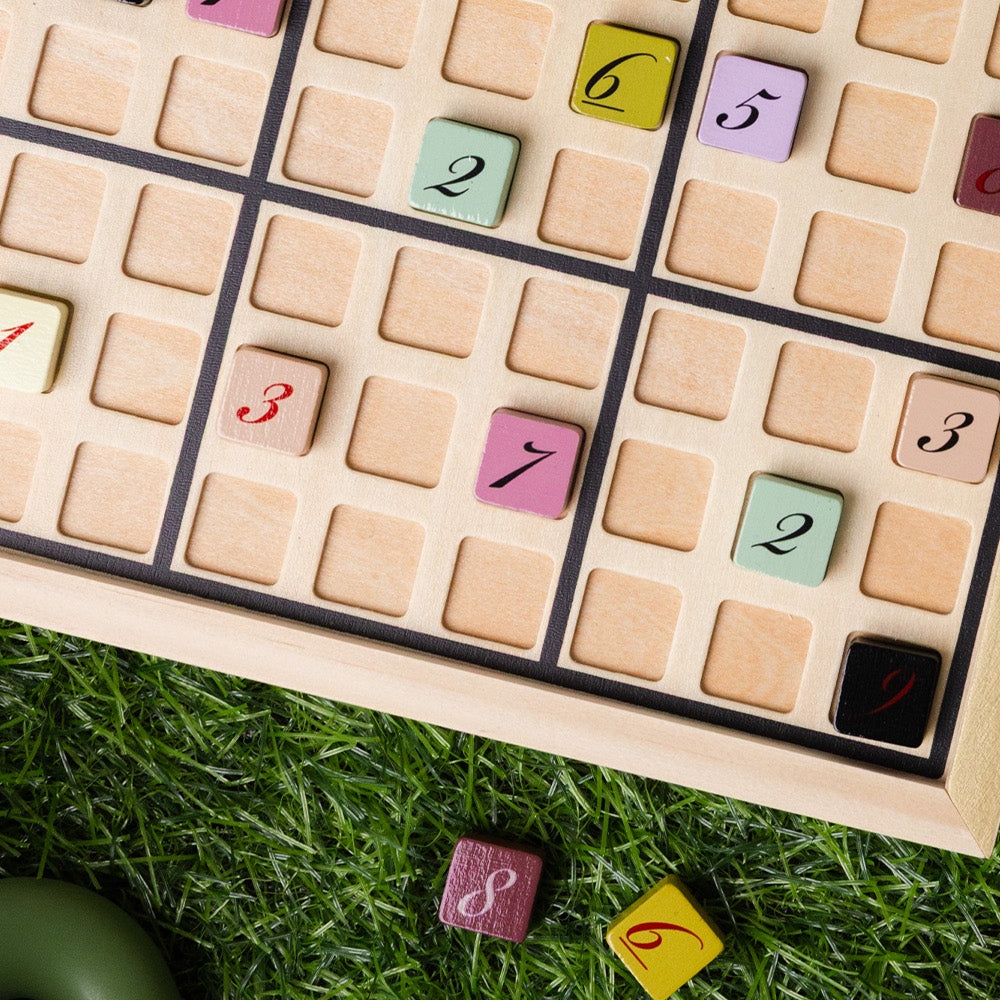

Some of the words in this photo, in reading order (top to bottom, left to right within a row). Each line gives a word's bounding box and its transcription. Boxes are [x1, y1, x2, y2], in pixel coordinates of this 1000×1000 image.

[582, 52, 657, 112] 6
[716, 89, 782, 130] 5
[424, 155, 485, 197] 2
[236, 383, 294, 424] 3
[917, 412, 974, 453] 3
[489, 441, 557, 487] 7
[751, 513, 813, 555] 2
[869, 670, 916, 715] 9
[458, 868, 517, 917] 8
[619, 921, 704, 970] 6
